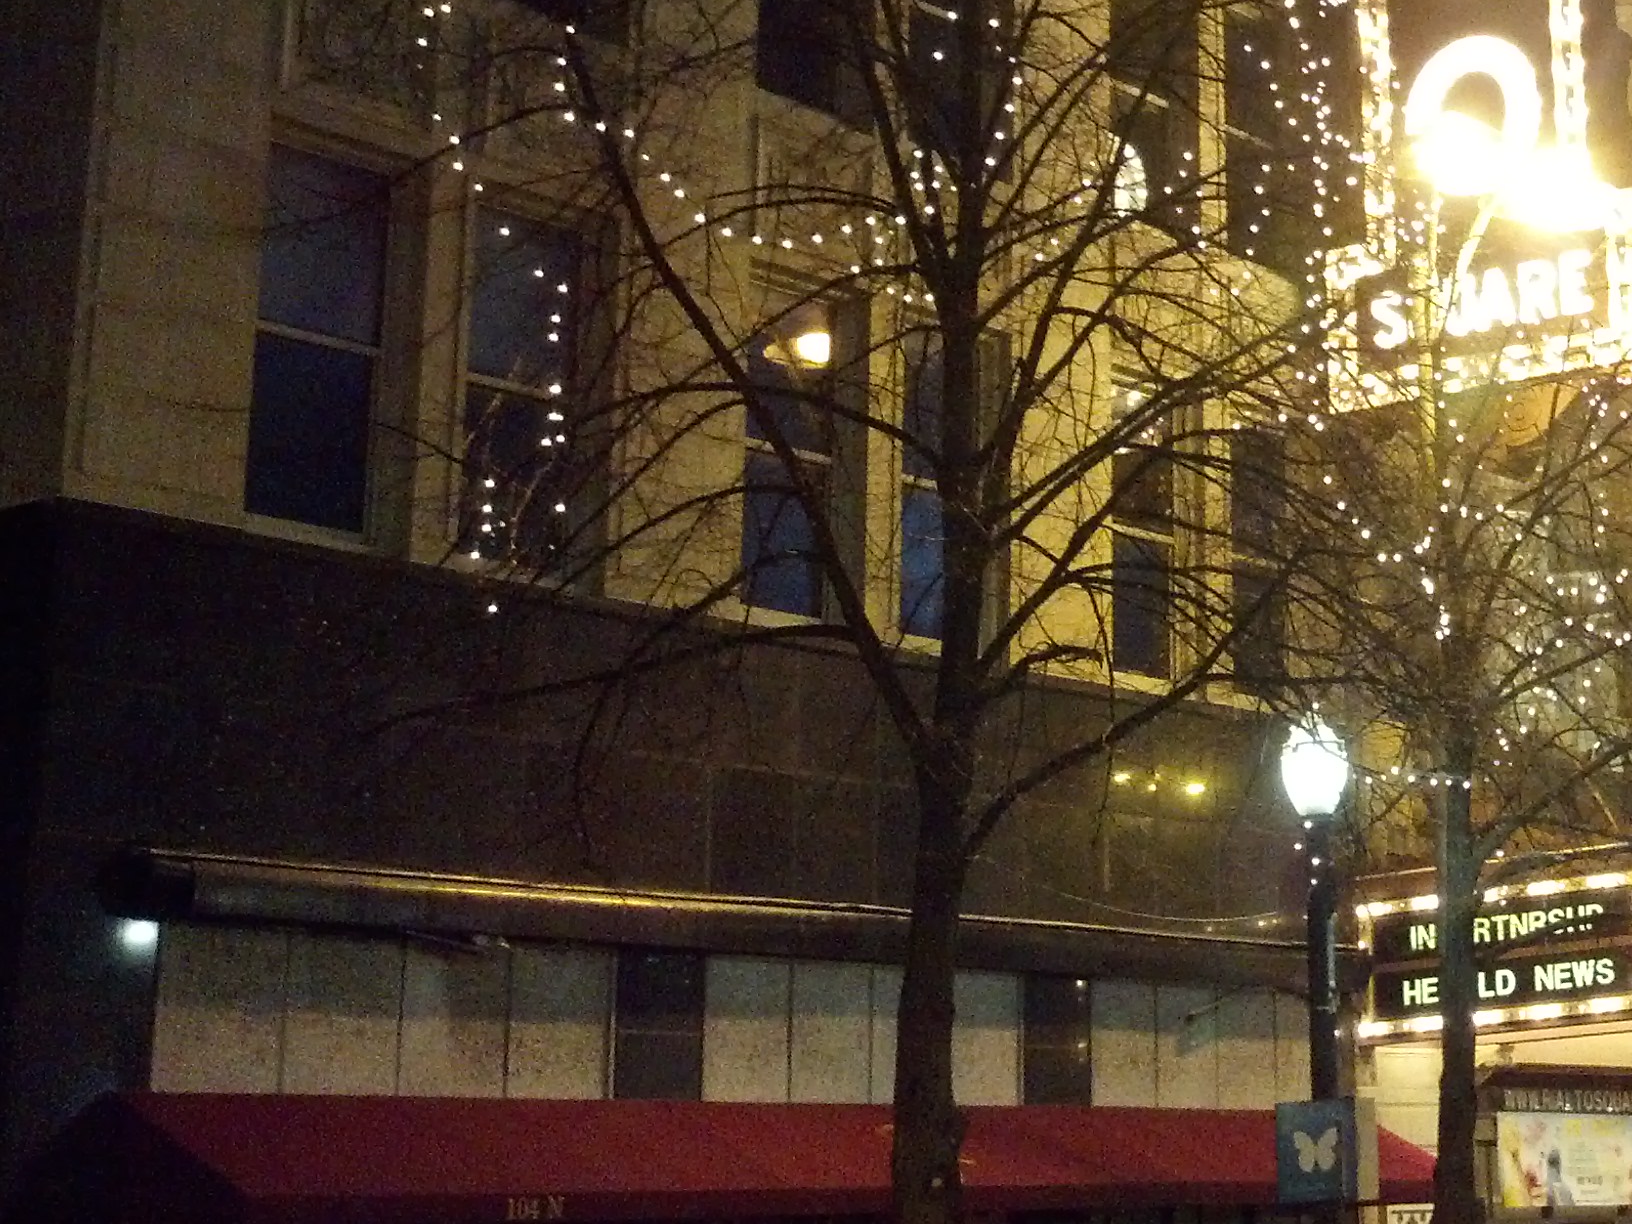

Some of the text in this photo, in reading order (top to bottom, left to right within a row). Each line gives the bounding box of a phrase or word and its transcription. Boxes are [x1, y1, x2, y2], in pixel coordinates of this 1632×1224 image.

[1371, 249, 1595, 349] SUARE
[1409, 923, 1437, 951] IN
[1403, 957, 1615, 1006] HELD NEWS
